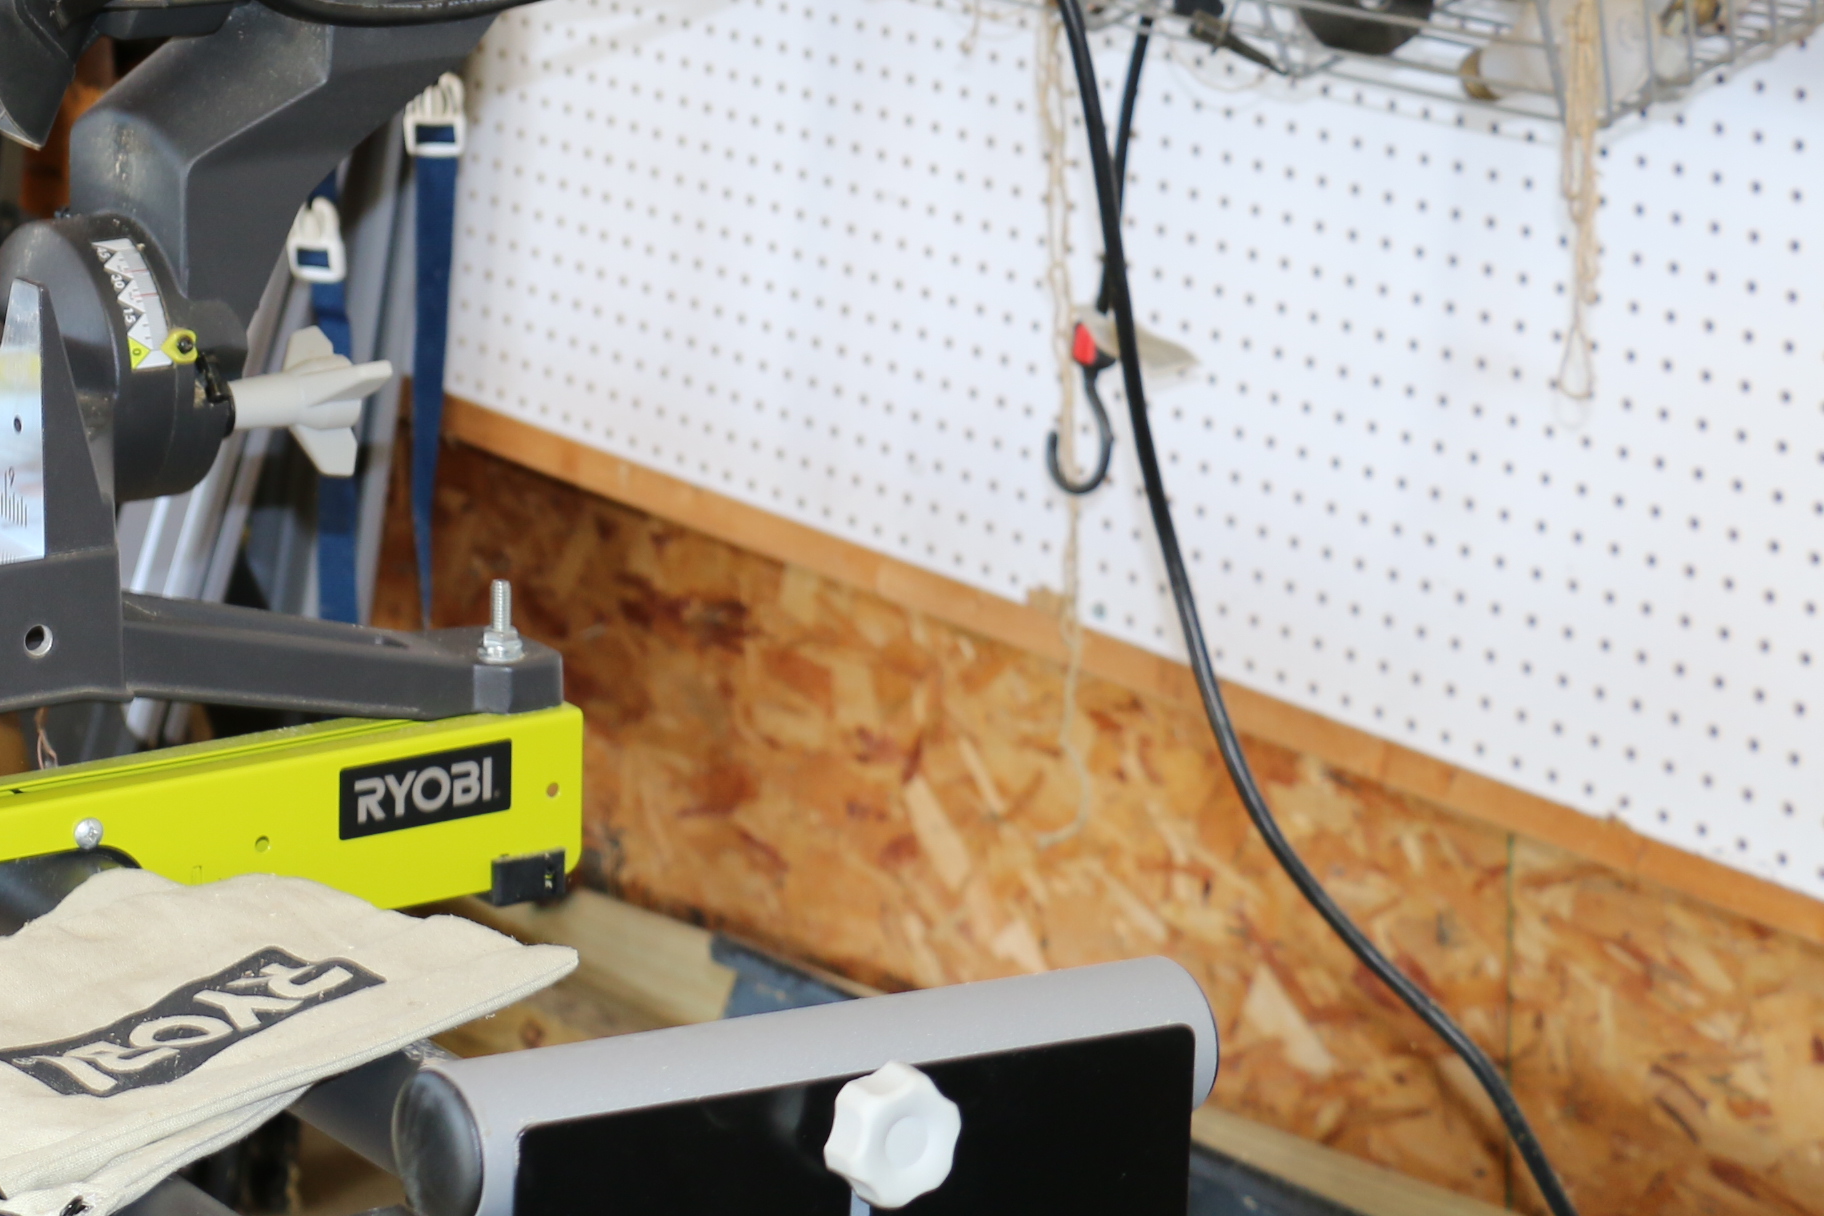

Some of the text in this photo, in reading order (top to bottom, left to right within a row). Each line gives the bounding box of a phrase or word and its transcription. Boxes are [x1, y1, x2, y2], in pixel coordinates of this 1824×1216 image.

[96, 246, 111, 259] 45
[111, 274, 125, 289] 30
[123, 307, 137, 323] 15
[9, 466, 15, 485] 9
[354, 756, 493, 825] RYOBI
